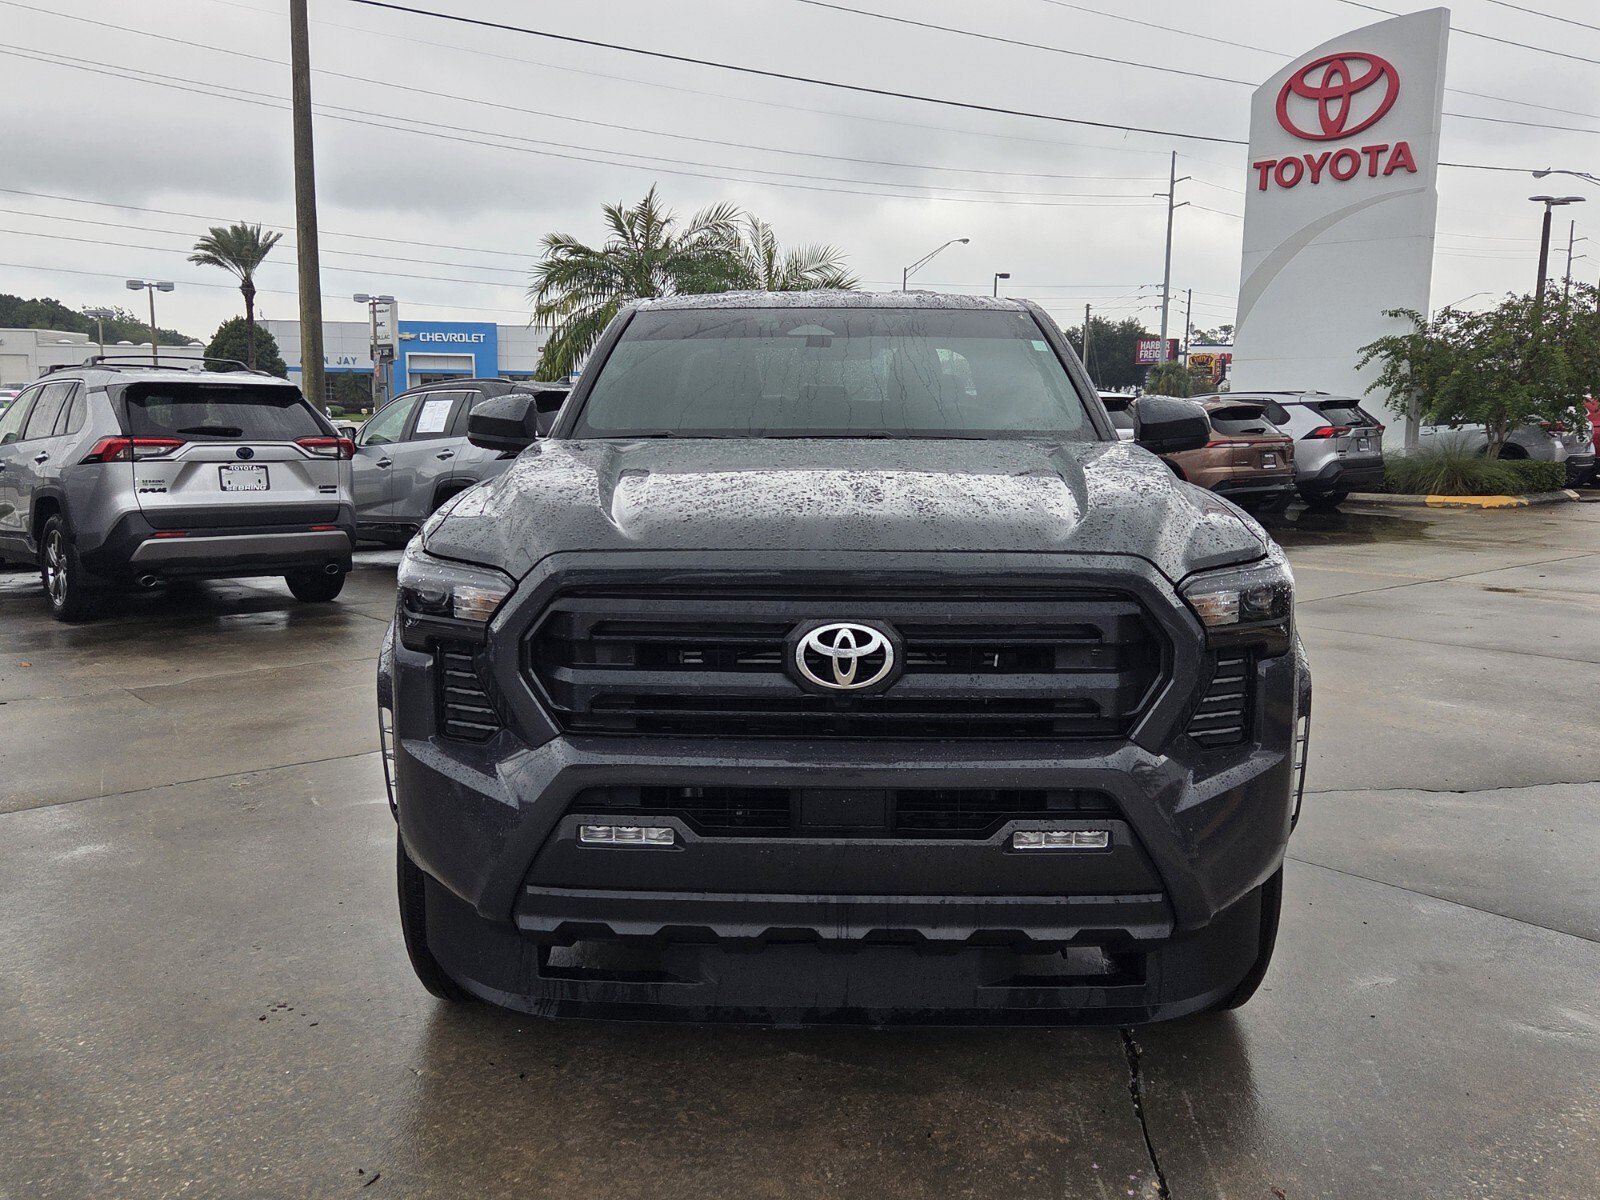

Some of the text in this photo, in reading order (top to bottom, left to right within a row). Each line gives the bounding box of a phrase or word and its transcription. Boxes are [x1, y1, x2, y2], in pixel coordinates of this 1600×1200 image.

[1253, 141, 1418, 191] TOYOTA
[419, 332, 486, 343] CHEVROLET
[1140, 340, 1170, 350] HARBR
[1139, 349, 1170, 359] FREIGT
[336, 356, 357, 365] JAY
